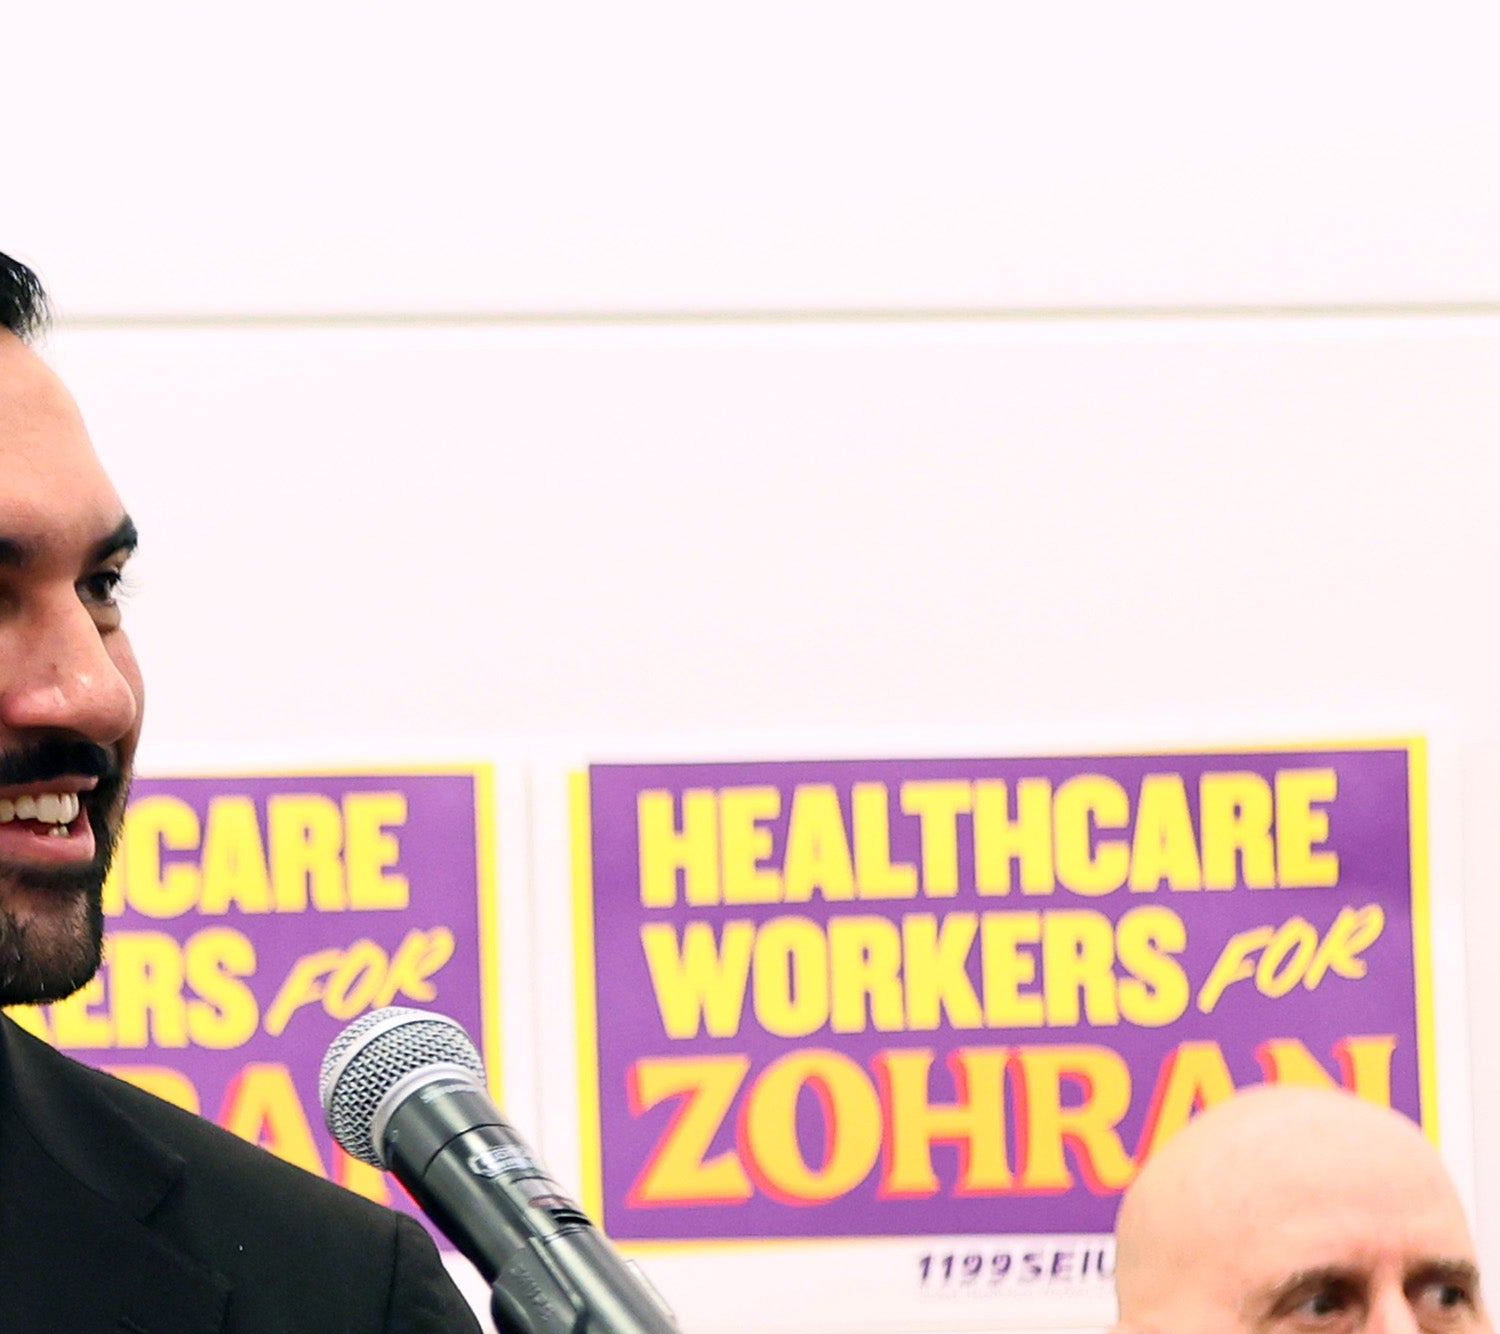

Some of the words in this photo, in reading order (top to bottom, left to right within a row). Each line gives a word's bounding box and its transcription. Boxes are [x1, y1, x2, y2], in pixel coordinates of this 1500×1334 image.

[638, 768, 1339, 908] HEALTHCARE
[265, 928, 454, 1036] FOR
[641, 904, 1190, 1040] WORKERS
[1197, 904, 1386, 1015] FOR
